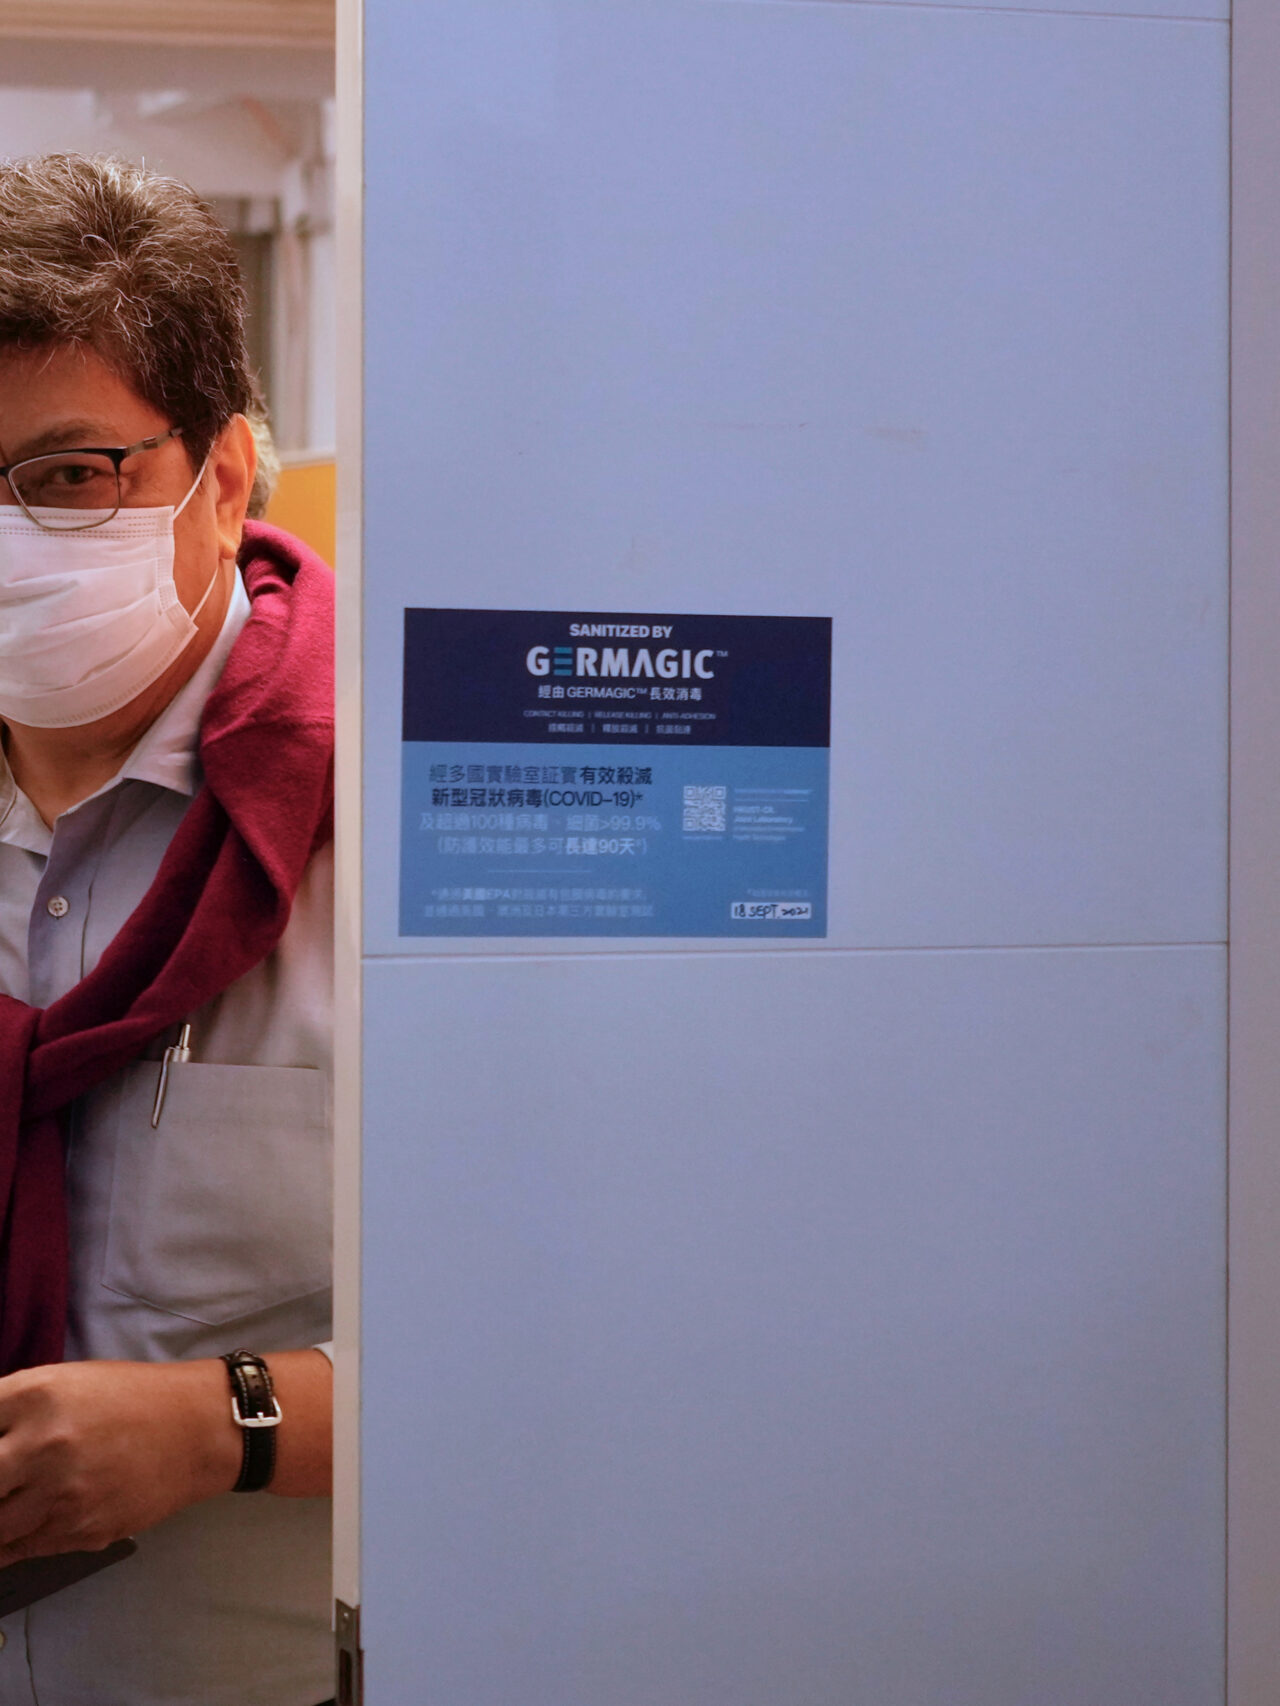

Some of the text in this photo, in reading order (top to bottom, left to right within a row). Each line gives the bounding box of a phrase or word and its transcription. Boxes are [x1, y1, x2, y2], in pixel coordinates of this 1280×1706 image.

[569, 623, 673, 639] SANITIZED BY
[538, 685, 565, 699] 經由
[650, 687, 702, 701] 長效消毒
[734, 904, 746, 917] 18
